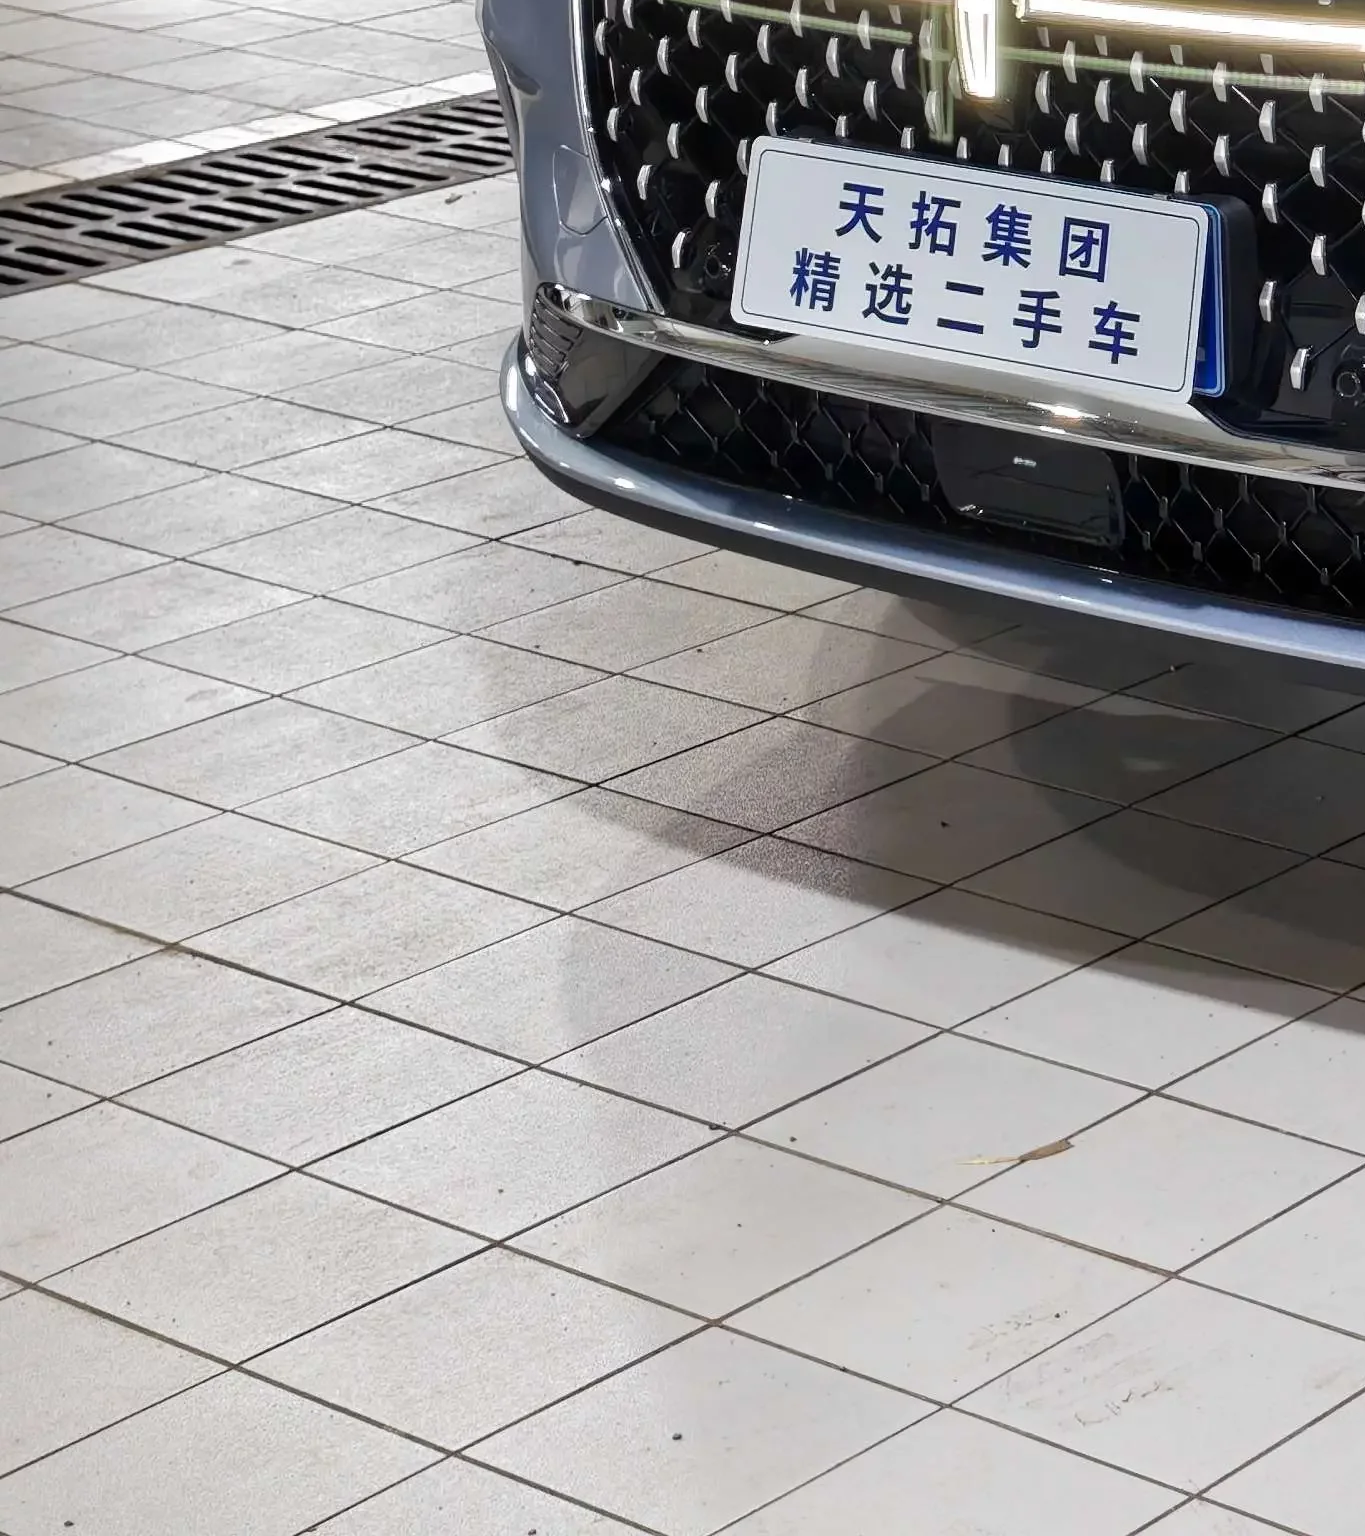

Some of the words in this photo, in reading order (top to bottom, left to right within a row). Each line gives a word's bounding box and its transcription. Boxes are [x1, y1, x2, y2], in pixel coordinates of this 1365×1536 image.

[835, 181, 1110, 282] 天拓集团
[789, 247, 1141, 364] 精选二手车
